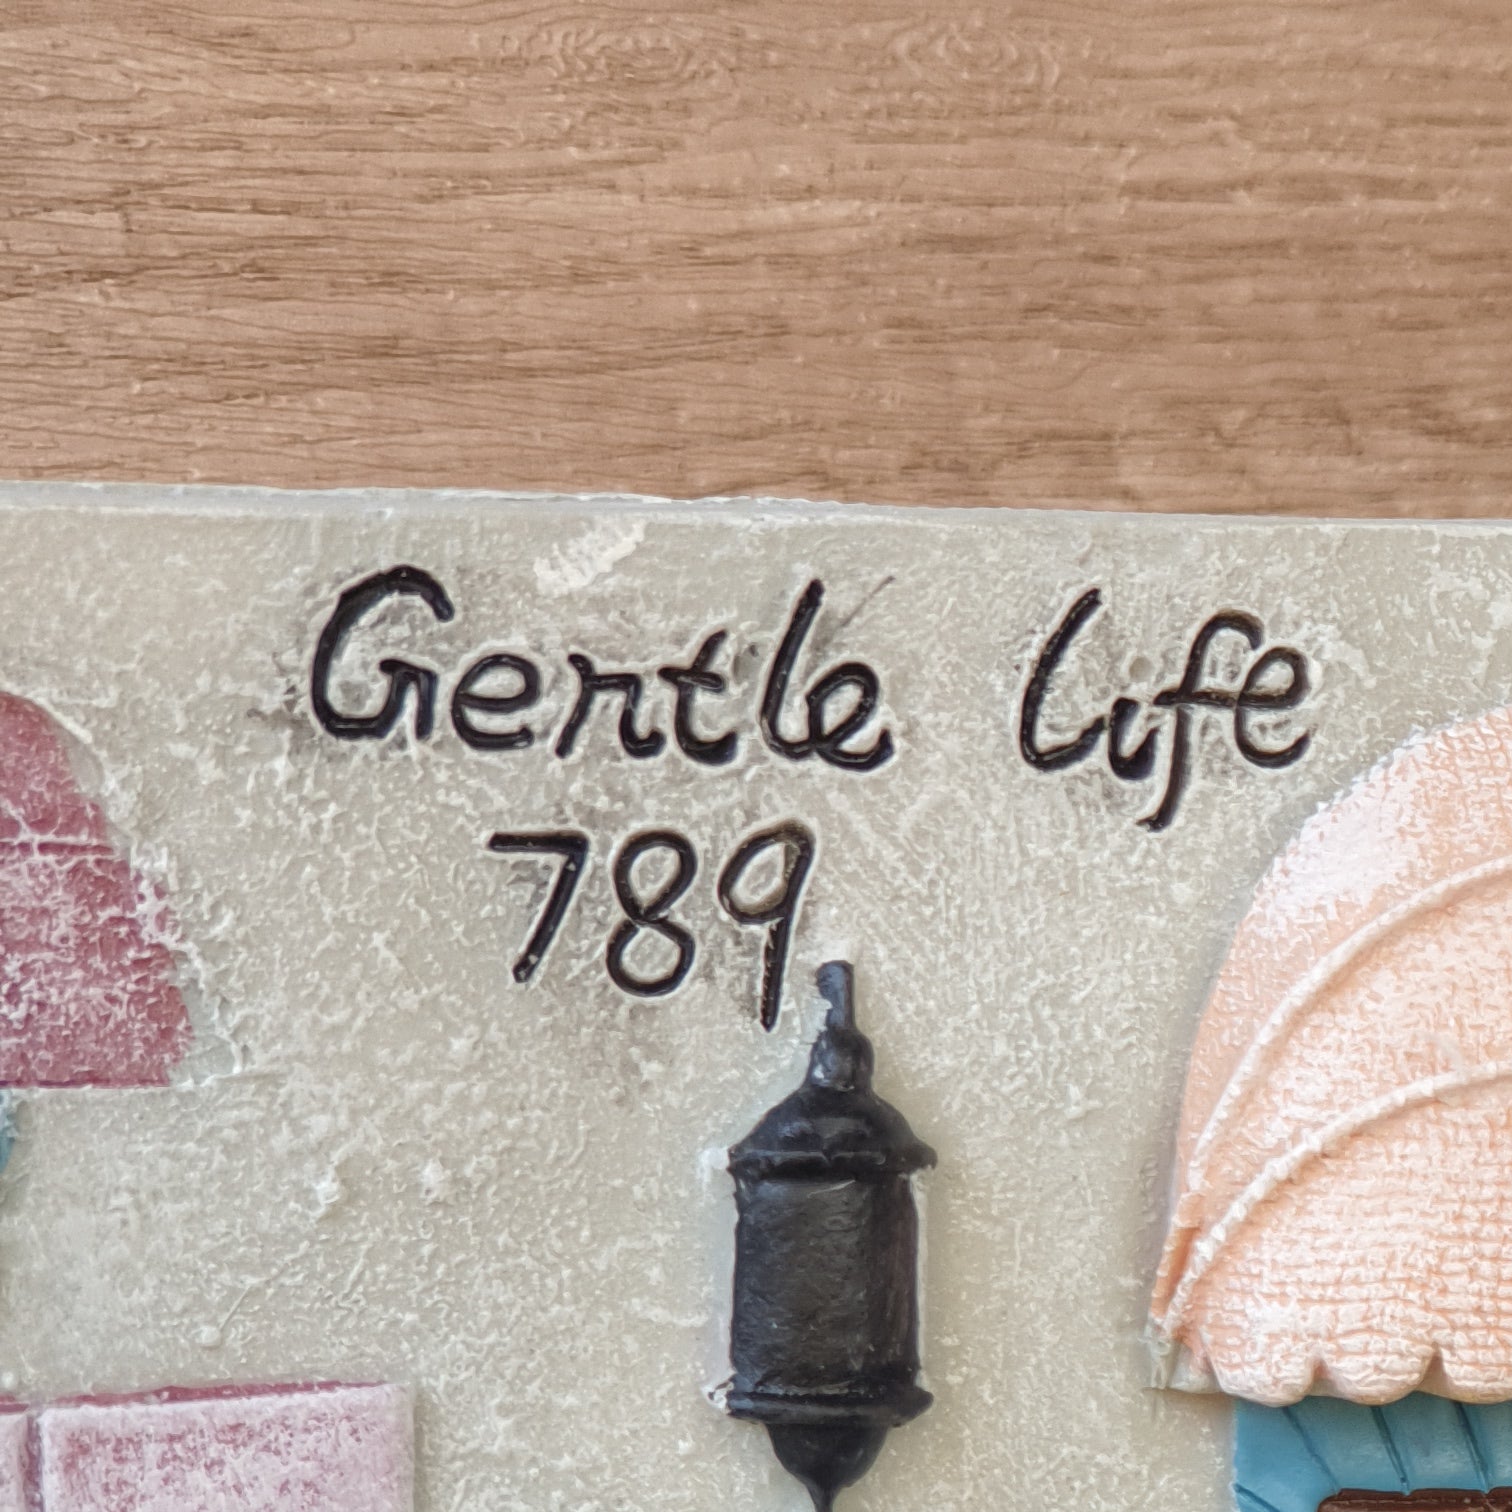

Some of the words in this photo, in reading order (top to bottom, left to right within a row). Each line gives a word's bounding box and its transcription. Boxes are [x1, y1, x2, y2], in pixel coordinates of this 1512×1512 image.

[311, 565, 895, 771] Gentle
[1018, 587, 1313, 831] Life
[488, 818, 816, 1032] 789
